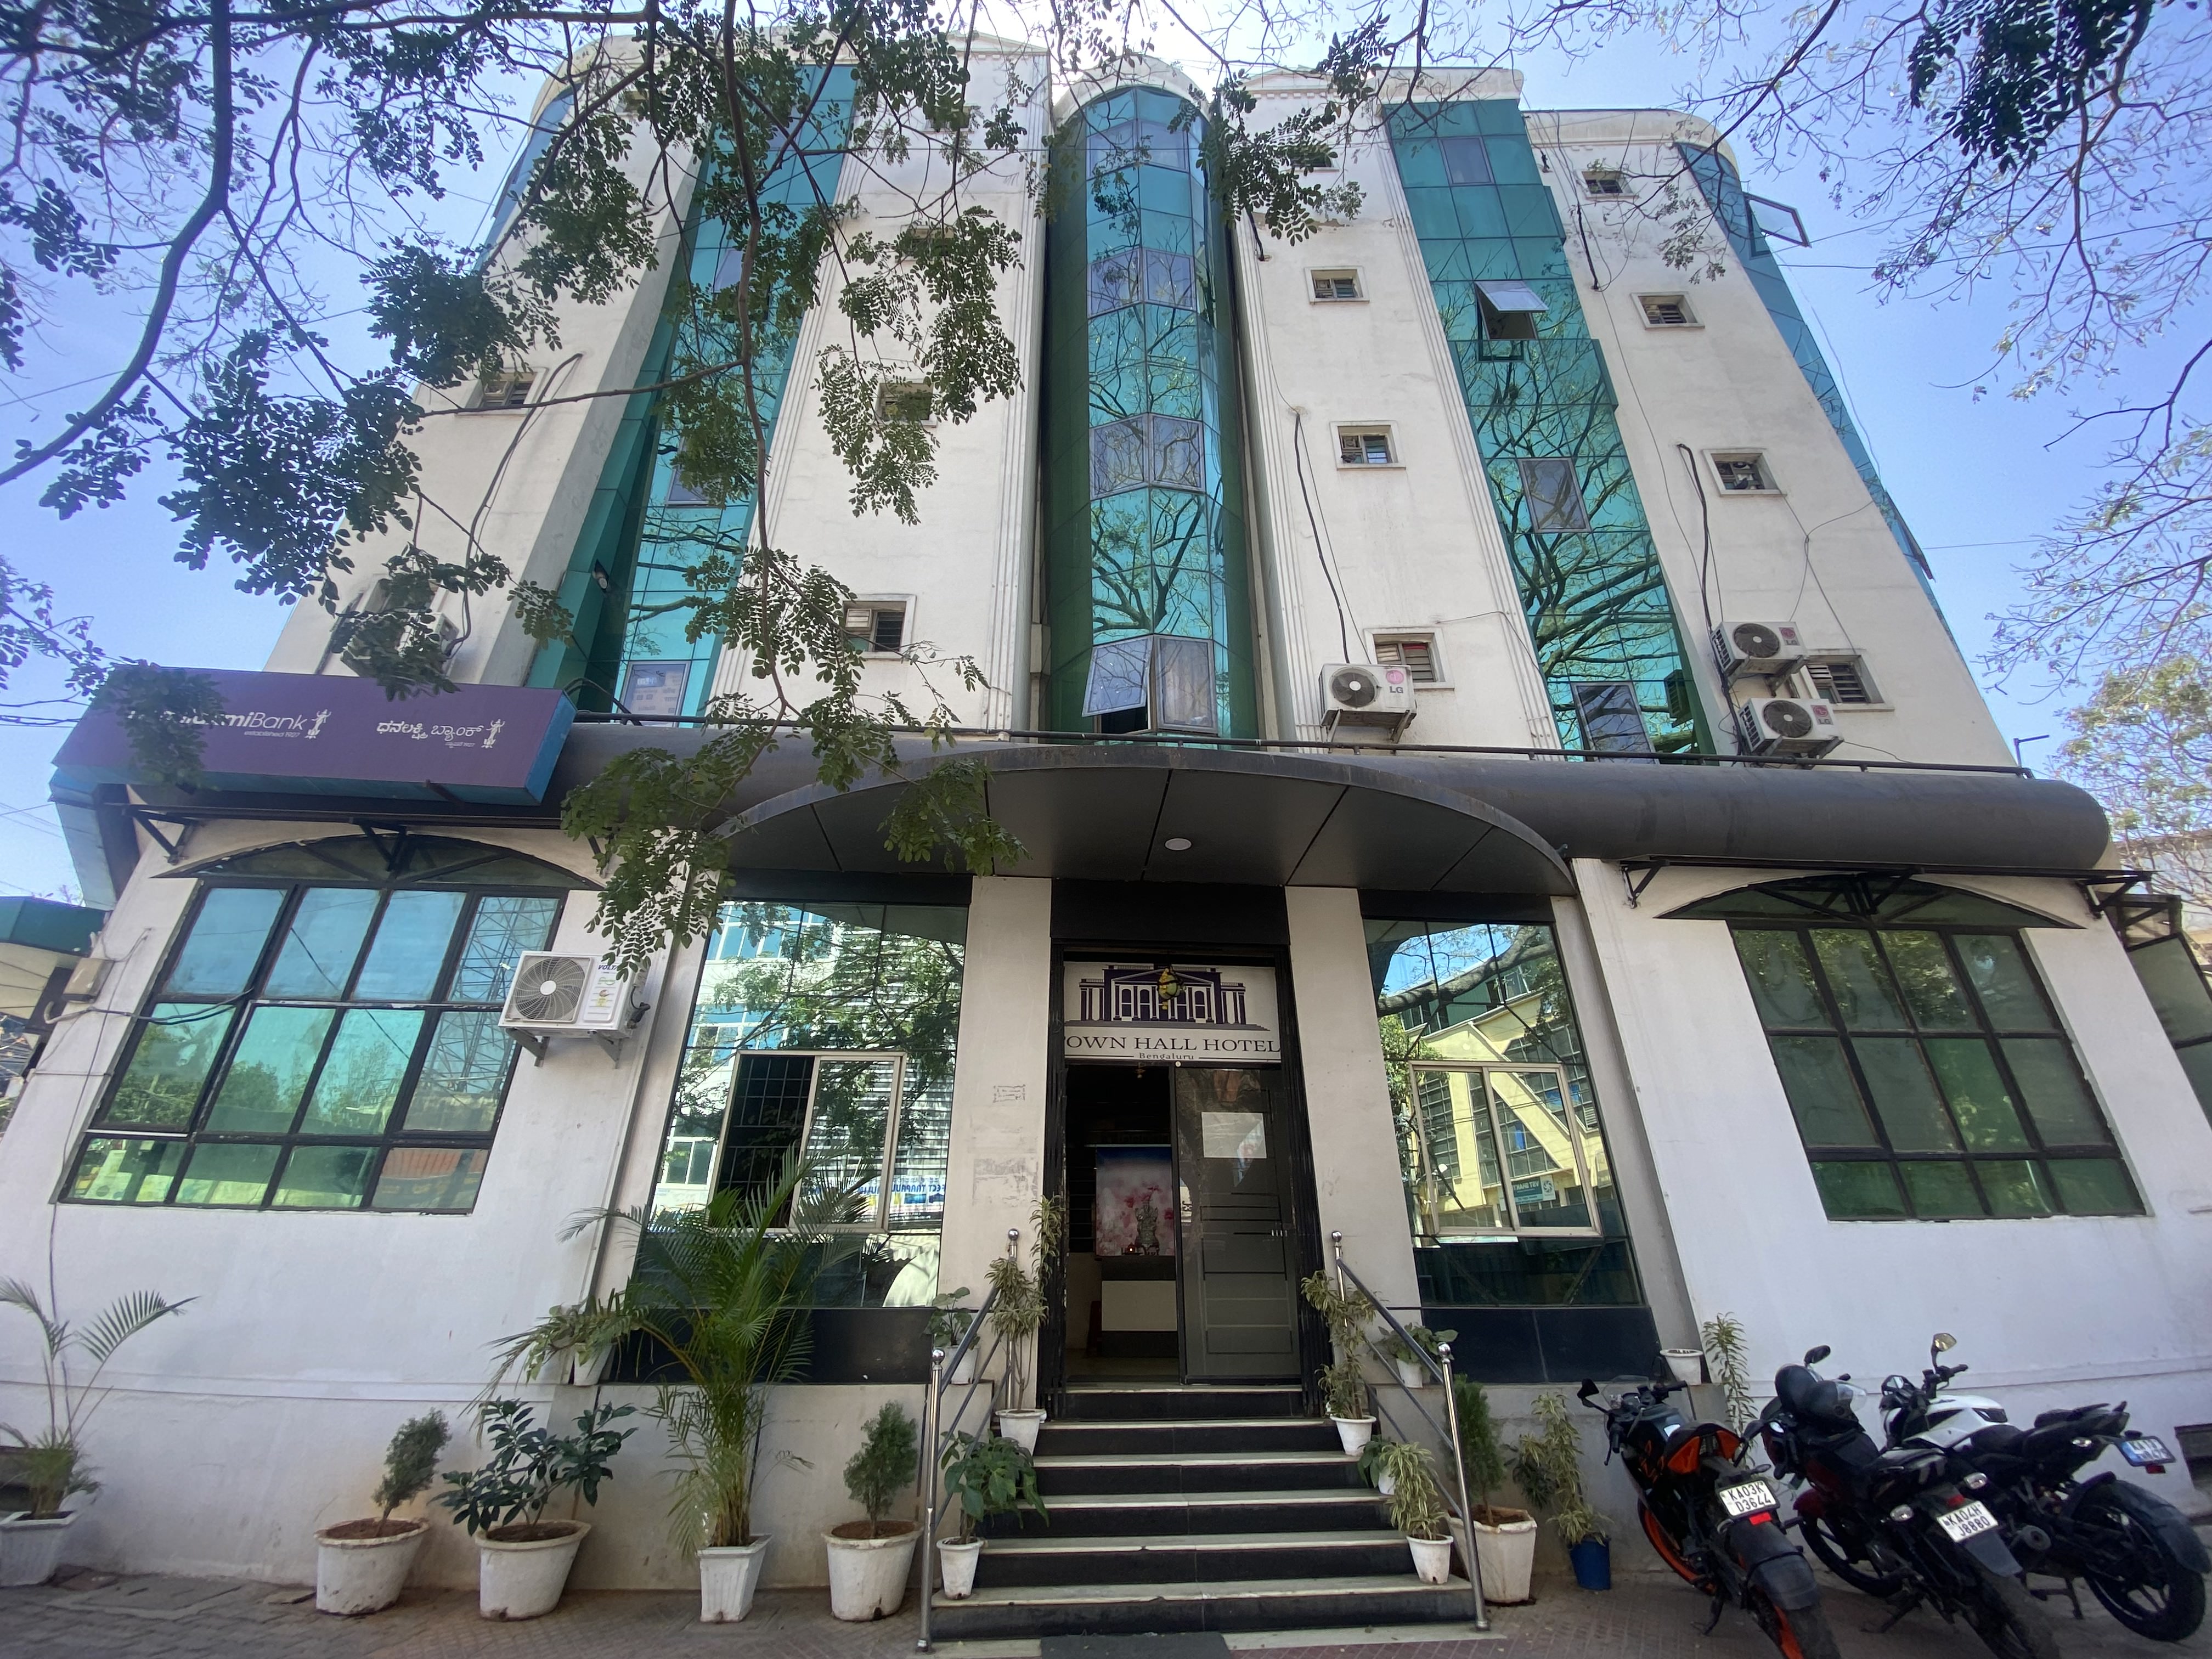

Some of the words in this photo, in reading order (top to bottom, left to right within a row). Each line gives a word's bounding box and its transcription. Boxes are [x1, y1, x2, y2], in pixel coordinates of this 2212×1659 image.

[431, 725, 484, 741] ಬ್ಯಾಂಕ್
[1064, 1036, 1127, 1049] OWN
[1134, 1037, 1197, 1050] HALL
[1203, 1039, 1281, 1052] HOTEL
[1138, 1052, 1194, 1060] Bengaluru
[1728, 1482, 1764, 1501] KA03K
[1735, 1493, 1771, 1512] D3644
[1946, 1505, 1982, 1525] KA04H
[1958, 1516, 1990, 1536] J8880
